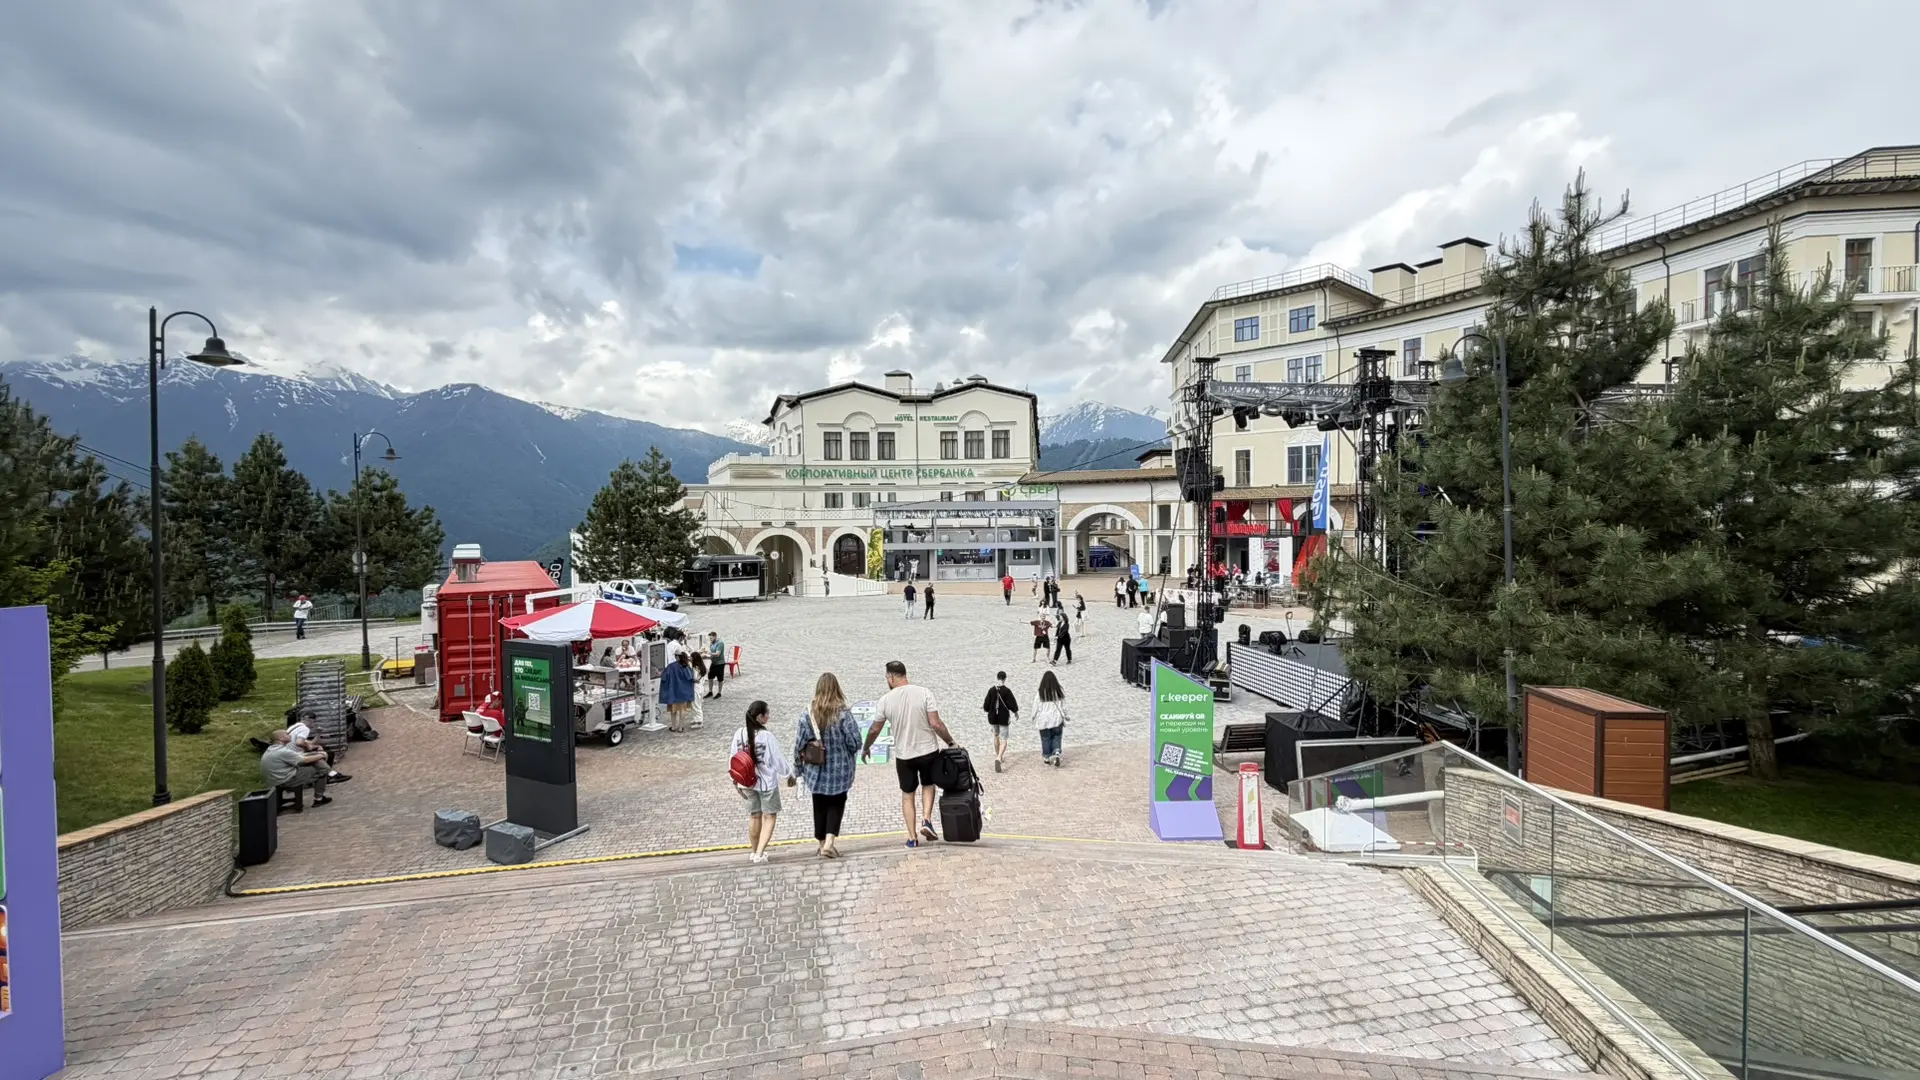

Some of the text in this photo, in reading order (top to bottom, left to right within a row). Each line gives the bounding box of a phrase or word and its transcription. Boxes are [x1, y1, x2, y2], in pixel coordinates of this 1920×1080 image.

[785, 467, 974, 480] КОРПОРАТИВНЫЙ ЦЕНТР СБЕРБАНКА
[1160, 692, 1209, 704] r_keeper
[1160, 712, 1195, 720] СКАНИРУЙ
[1181, 727, 1209, 735] уровень
